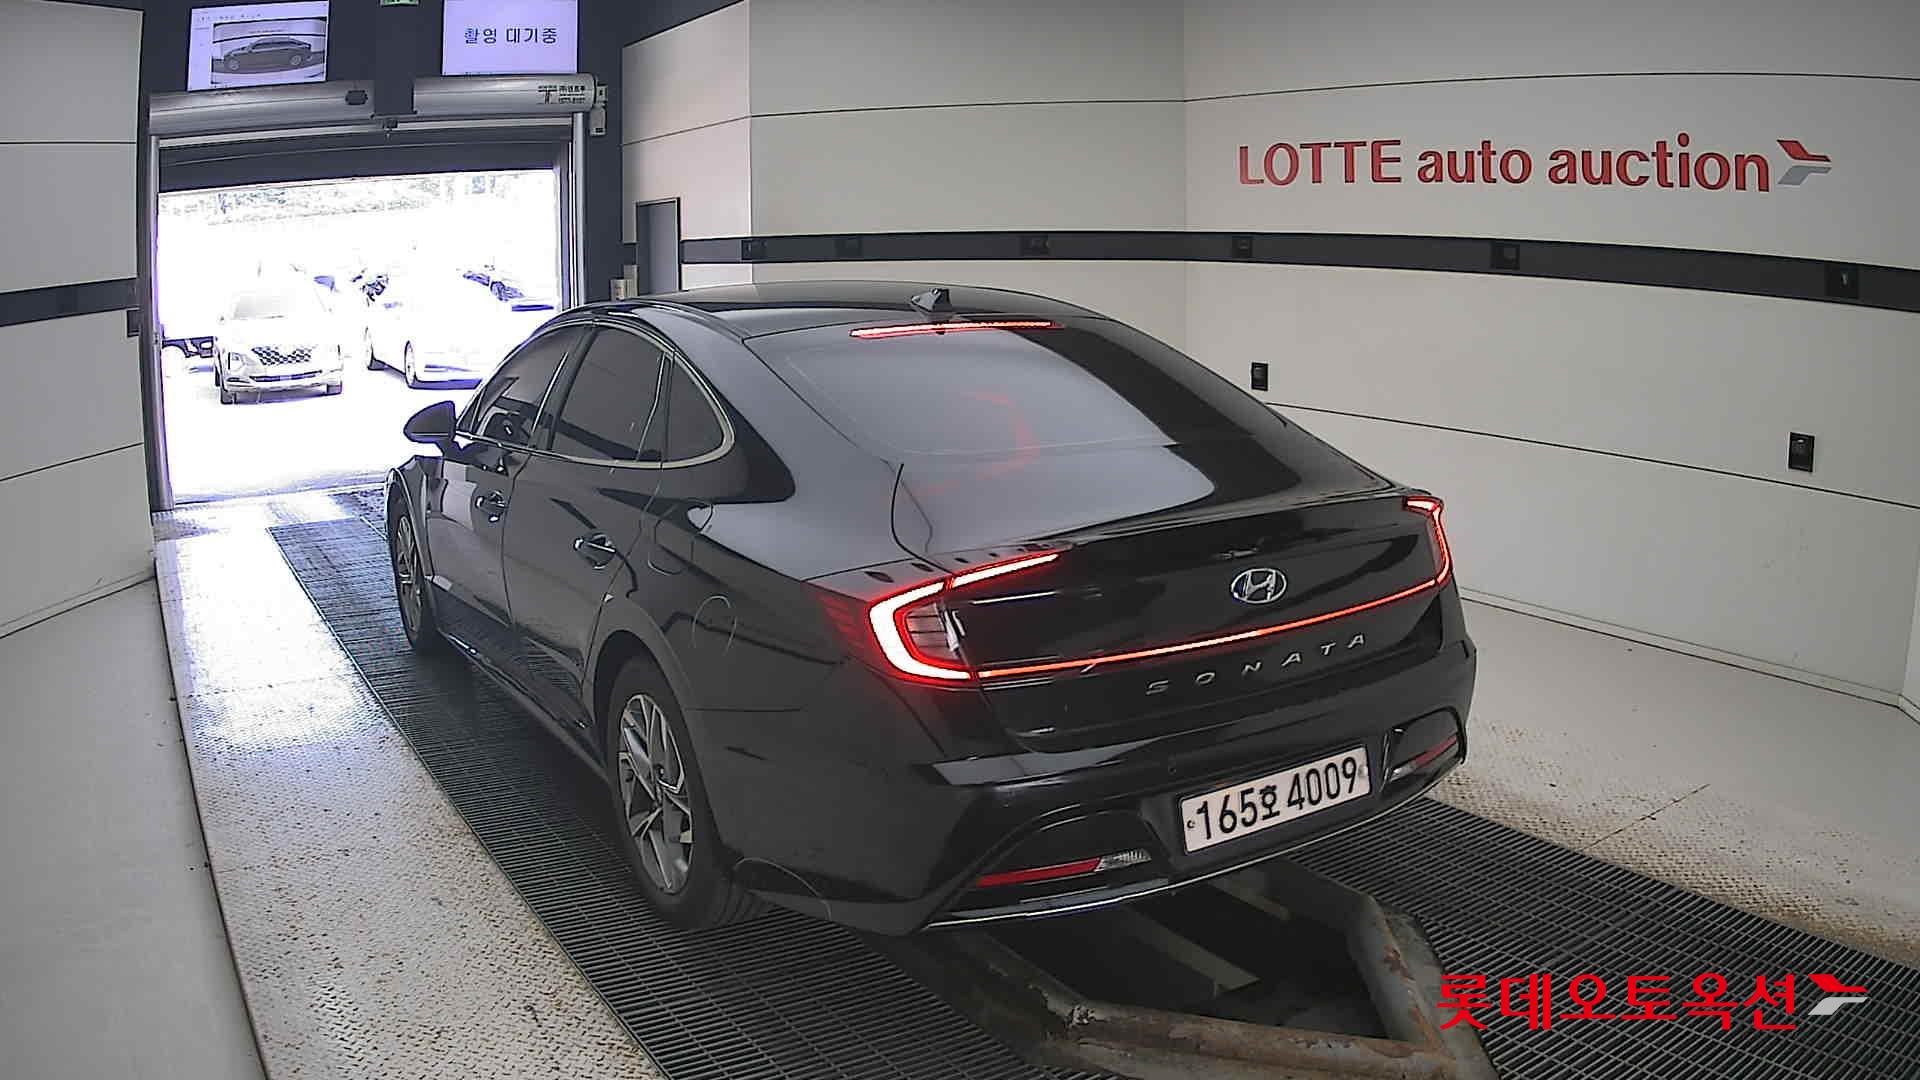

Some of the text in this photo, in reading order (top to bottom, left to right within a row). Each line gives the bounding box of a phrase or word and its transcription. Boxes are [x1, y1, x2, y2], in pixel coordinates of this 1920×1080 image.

[464, 27, 557, 44] 촬영 대기중
[1239, 132, 1770, 192] LOTTE auto auction
[1146, 634, 1366, 696] SONATA
